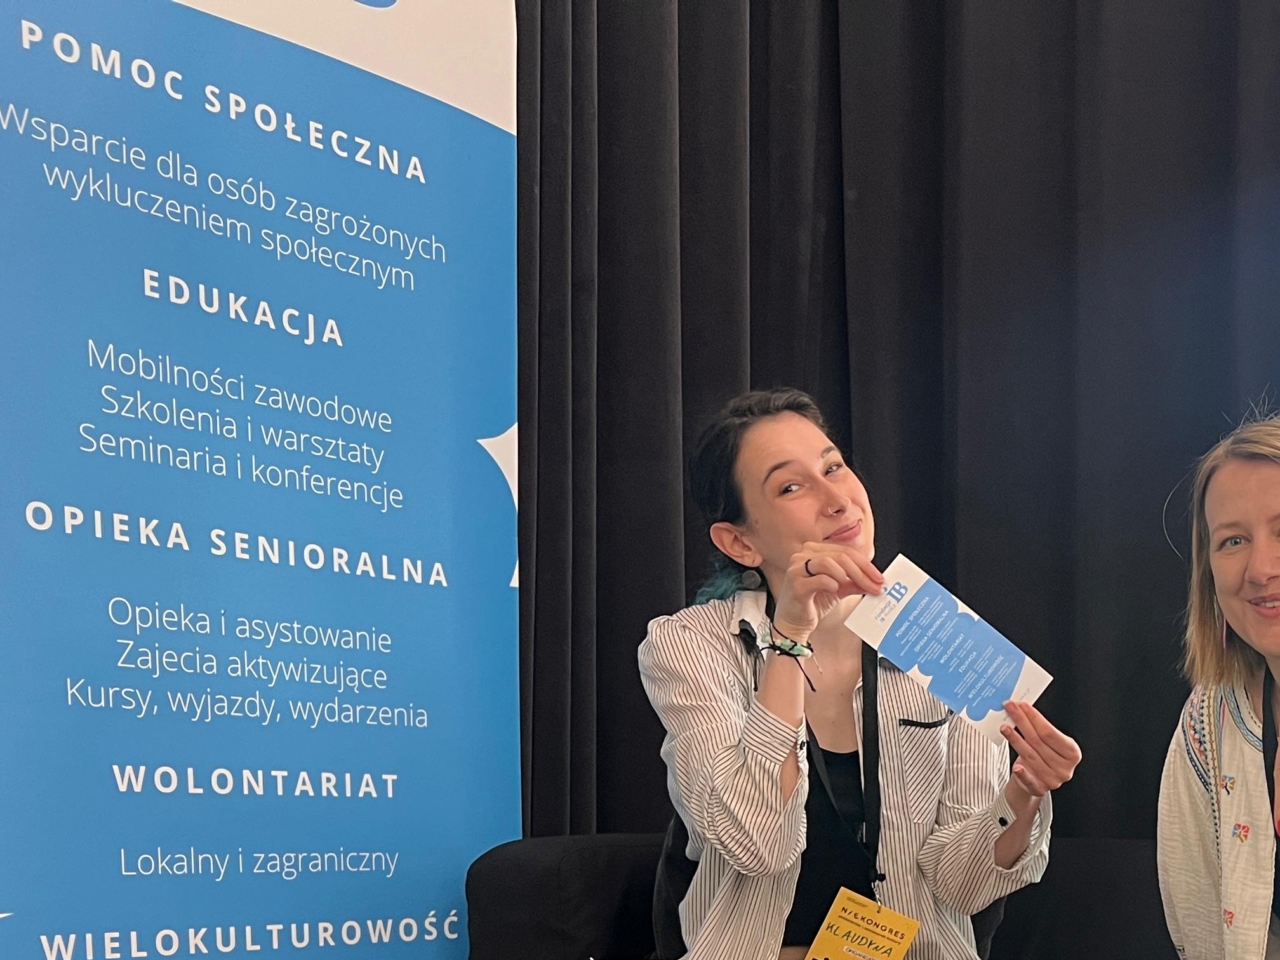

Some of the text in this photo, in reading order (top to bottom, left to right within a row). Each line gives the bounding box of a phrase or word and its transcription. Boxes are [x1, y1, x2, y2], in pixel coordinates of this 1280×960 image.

[20, 19, 426, 184] POMOC SPOŁECZNA
[0, 103, 446, 264] Wsparcie dla osób zagrożonych
[43, 162, 414, 291] wykluczeniem społecznym
[143, 269, 344, 347] EDUKACJA
[87, 339, 393, 433] Mobilności zawodowe
[100, 385, 385, 475] Szkolenia i warsztaty
[79, 423, 404, 514] Seminaria i konferencje
[25, 500, 449, 588] OPIEKA SENIORALNA
[107, 596, 392, 653] Opieka i asystowanie
[116, 639, 388, 694] Zajecia aktywizujące
[66, 677, 429, 729] Kursy, wyjazdy, wydarzenia
[111, 764, 398, 798] WOLONTARIAT
[120, 847, 399, 882] Lokalny i zagraniczny
